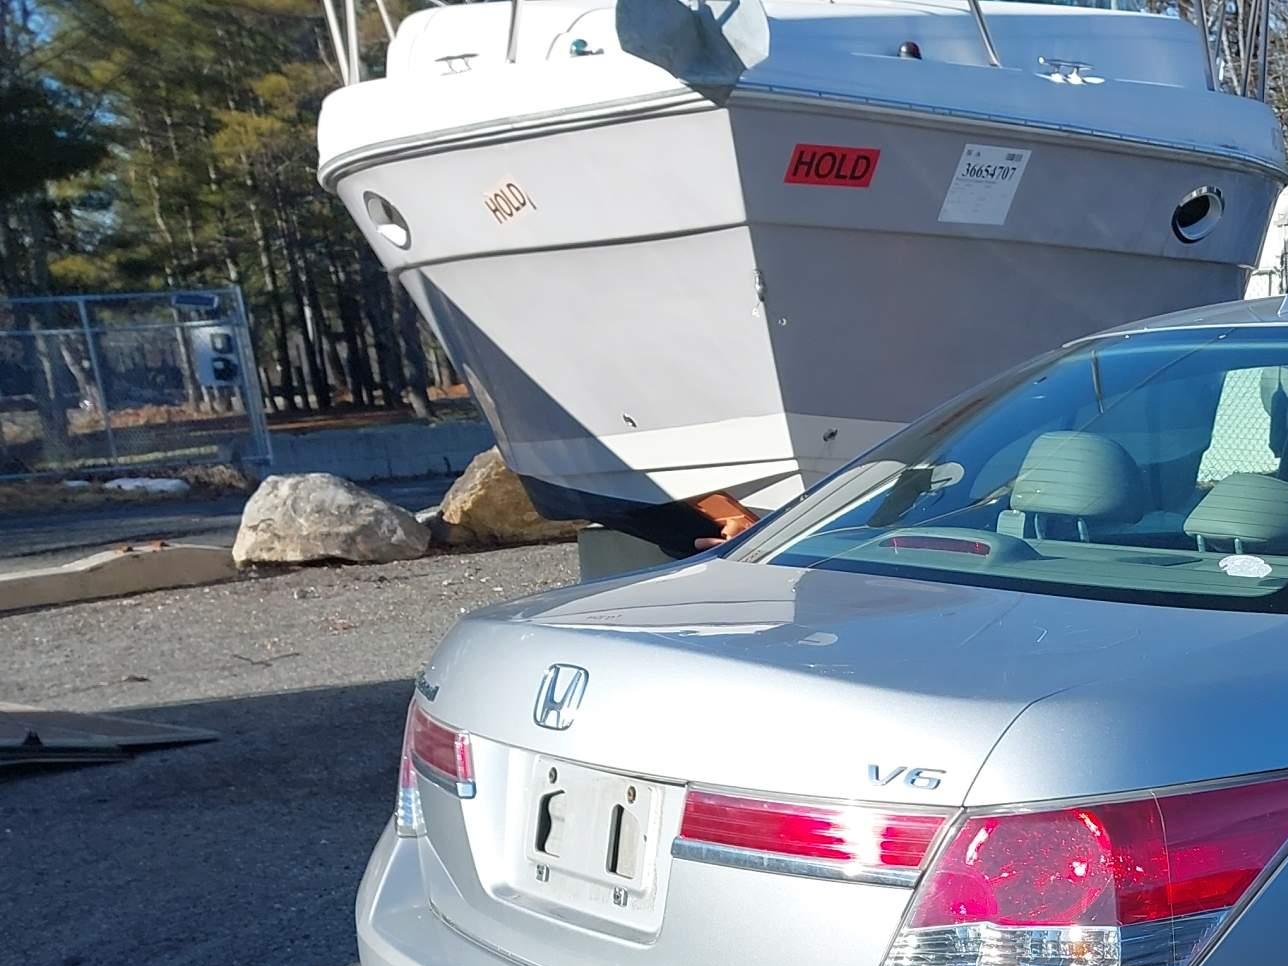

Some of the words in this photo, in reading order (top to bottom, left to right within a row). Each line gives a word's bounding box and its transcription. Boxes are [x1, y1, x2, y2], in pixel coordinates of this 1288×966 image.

[793, 150, 871, 181] HOLD
[961, 162, 1017, 181] 36654707
[485, 183, 527, 224] HOLD
[867, 763, 947, 790] V6
